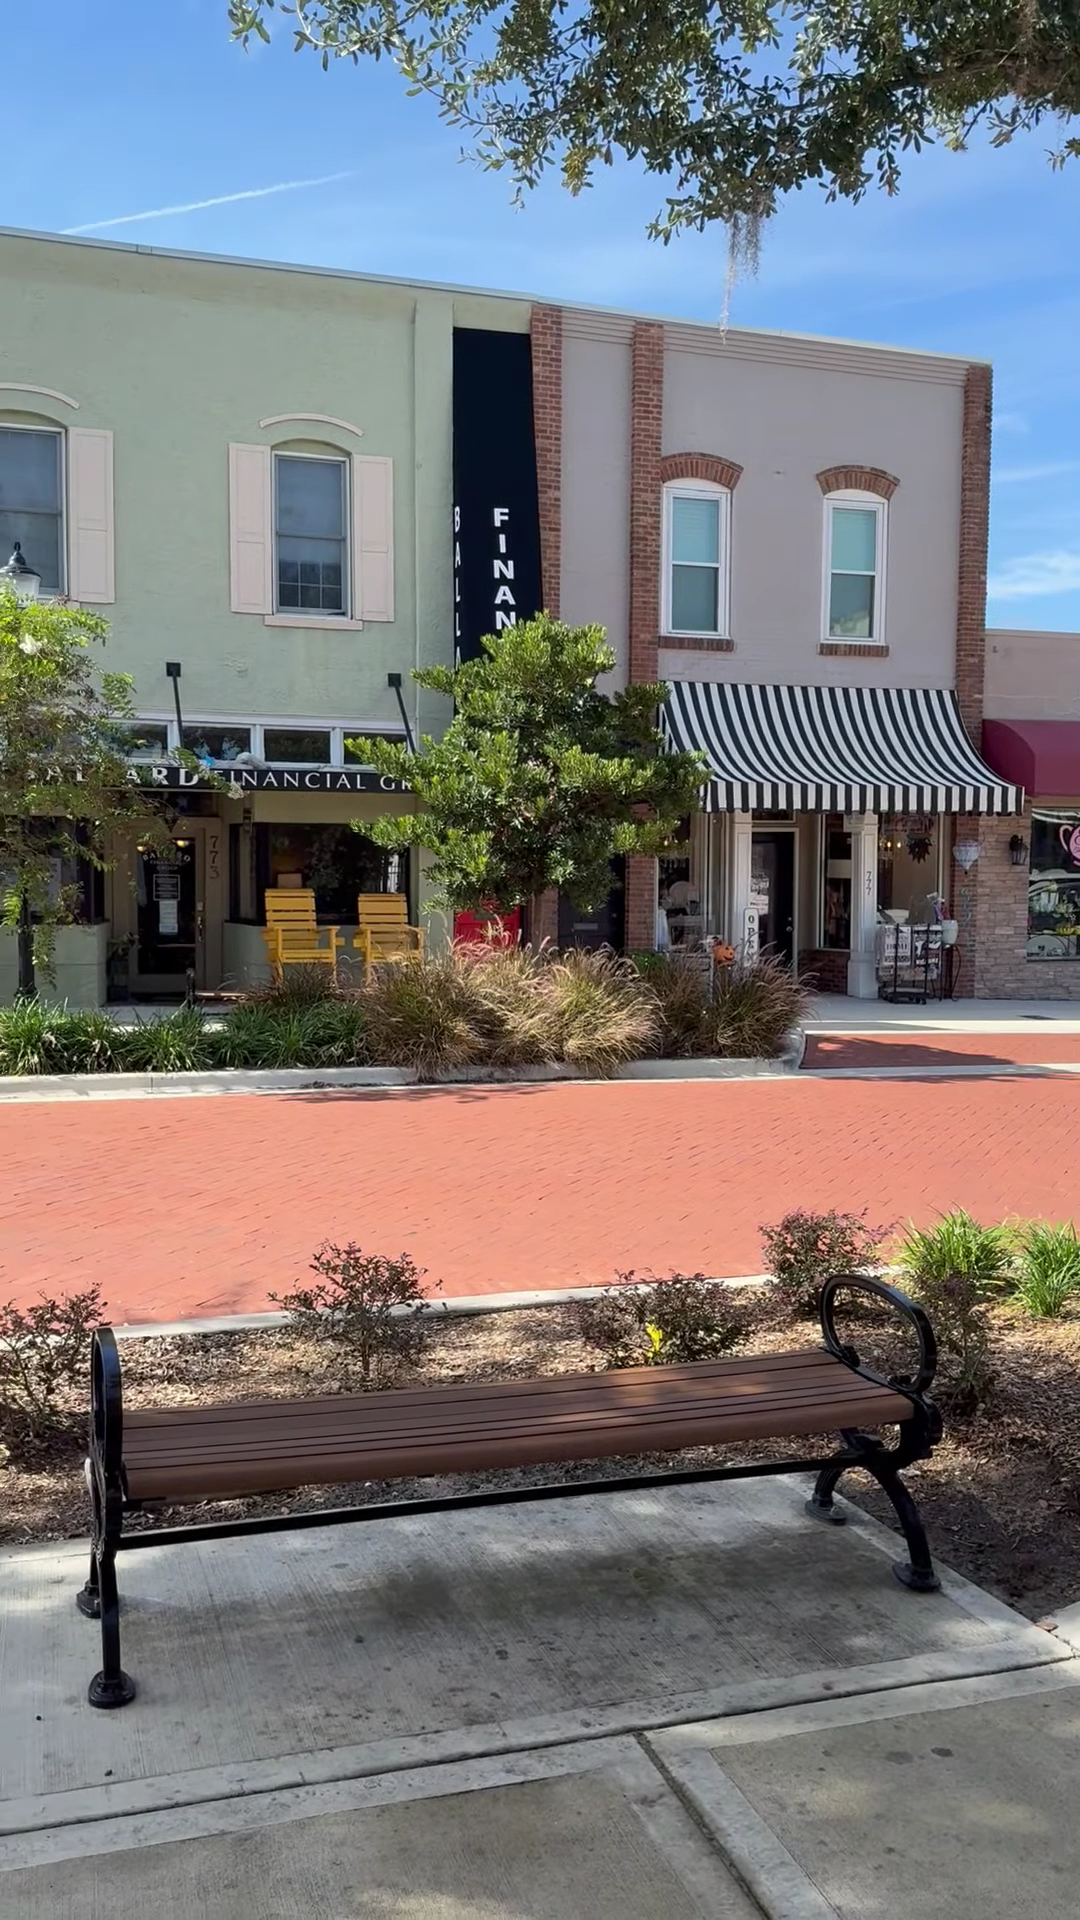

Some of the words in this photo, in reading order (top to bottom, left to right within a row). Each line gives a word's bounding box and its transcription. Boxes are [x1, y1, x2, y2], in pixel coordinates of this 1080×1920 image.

[493, 507, 517, 630] FINAN
[26, 763, 200, 787] ALARD
[379, 774, 413, 791] GR
[209, 835, 220, 879] 773
